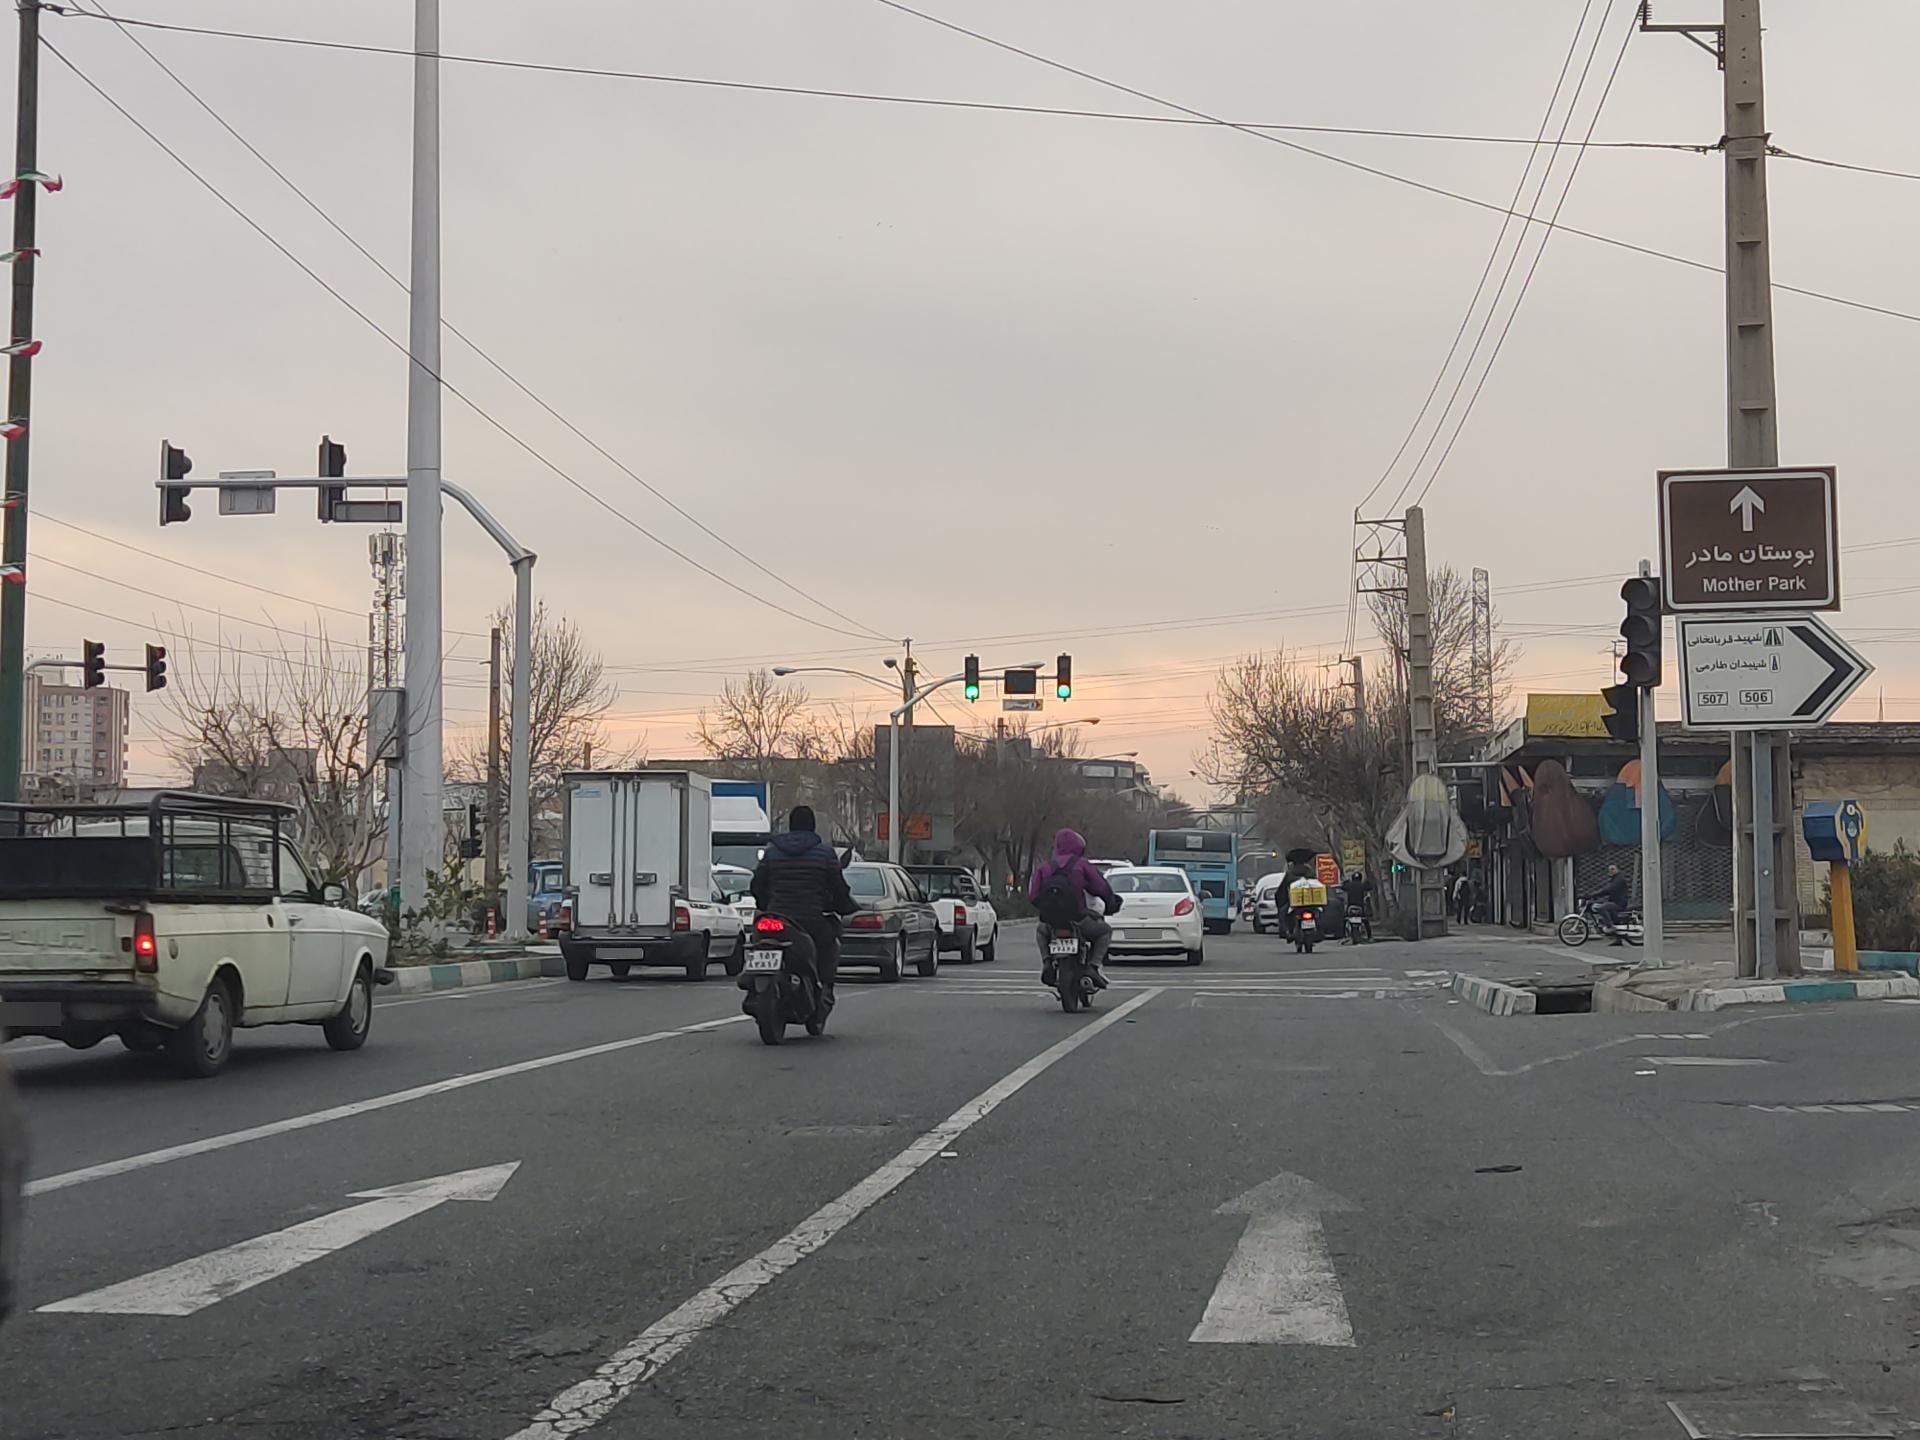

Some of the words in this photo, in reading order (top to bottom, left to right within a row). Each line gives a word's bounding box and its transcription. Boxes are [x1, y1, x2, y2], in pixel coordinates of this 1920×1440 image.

[1684, 545, 1733, 569] مادر
[1739, 543, 1815, 568] بوستان
[1702, 576, 1763, 592] Mother
[1768, 575, 1807, 591] Park
[1734, 632, 1762, 646] شهید
[1695, 658, 1728, 673] طارمی
[1729, 658, 1767, 671] شهیدان
[1702, 693, 1724, 704] 507
[1745, 691, 1768, 703] 506
